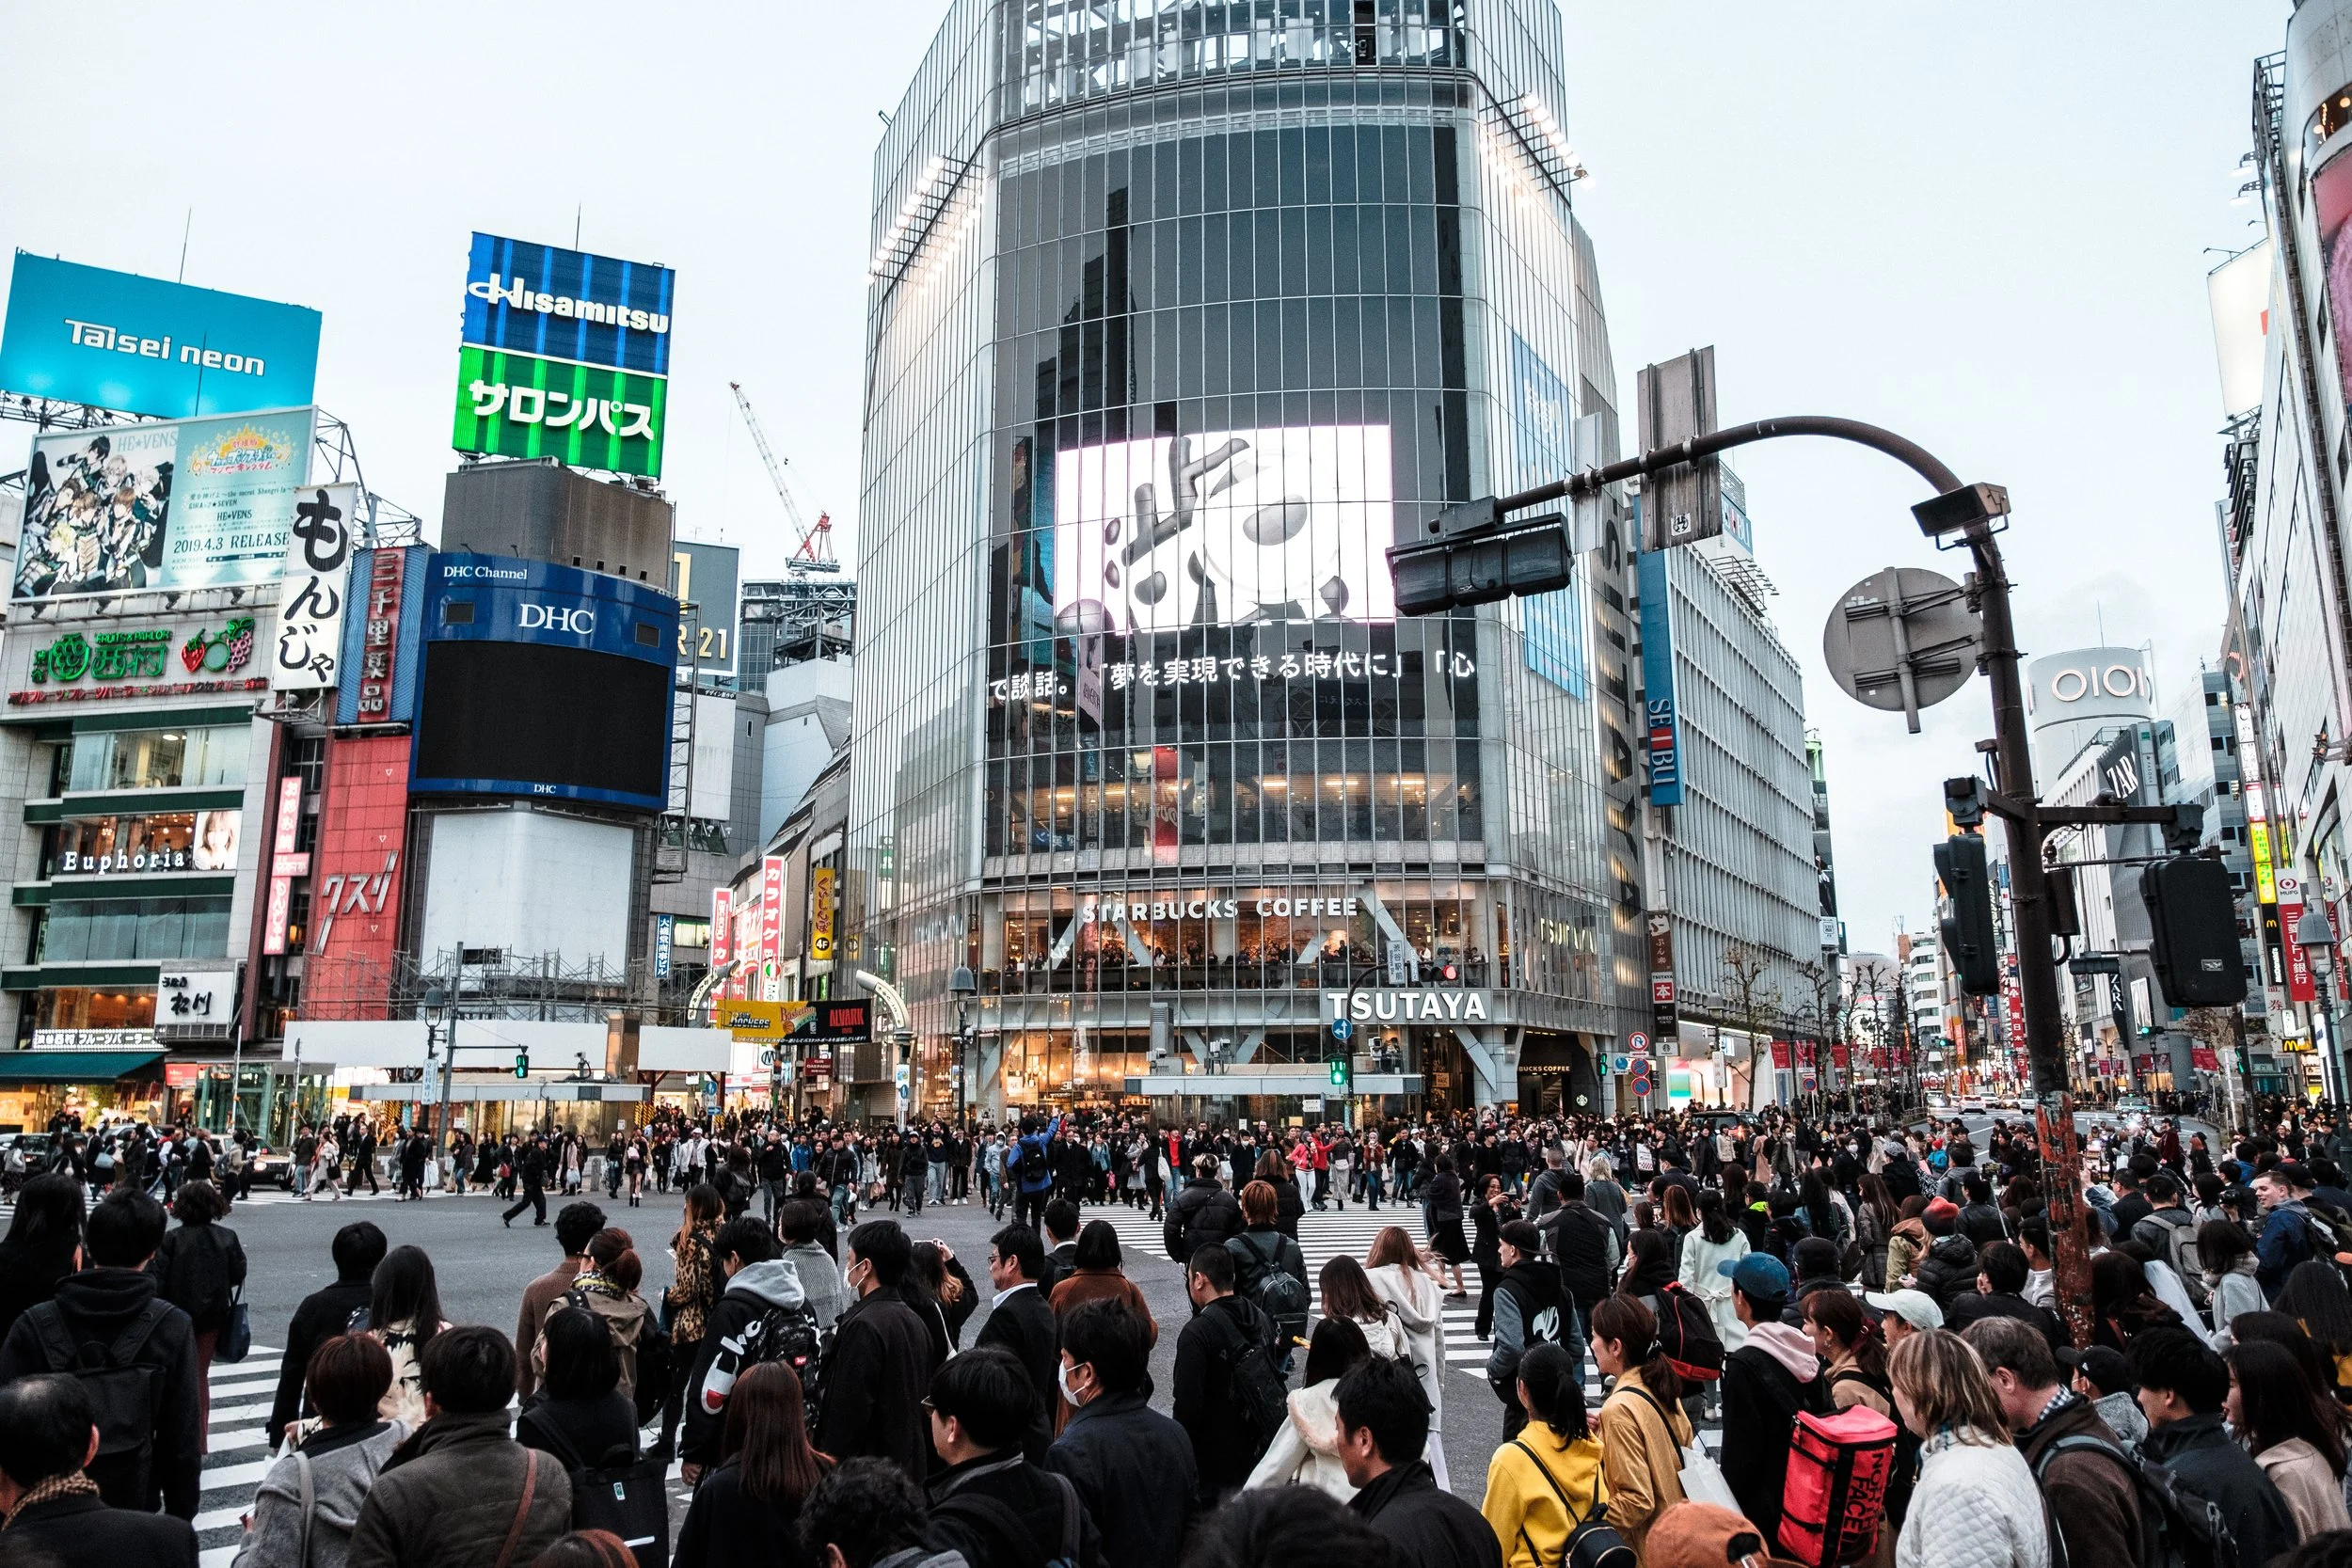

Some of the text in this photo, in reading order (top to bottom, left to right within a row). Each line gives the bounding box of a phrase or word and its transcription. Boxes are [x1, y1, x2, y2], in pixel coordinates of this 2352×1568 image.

[469, 273, 669, 334] Hisamitsu
[64, 318, 265, 377] Taisei neon
[469, 379, 655, 441] サロンパス
[173, 531, 290, 554] 2019.4.3 RELEASE
[278, 489, 349, 683] もんじゃ
[443, 565, 528, 580] DHC Channel
[358, 553, 399, 713] 三千里薬品
[518, 603, 595, 636] DHC
[91, 642, 168, 680] 西村
[990, 670, 1068, 701] で談話。
[1099, 649, 1402, 690] 「夢を実現できる時代に」
[1435, 649, 1475, 677] 「心
[2052, 664, 2146, 702] OIOI
[1648, 697, 1676, 785] SEIBU
[533, 784, 557, 795] DHC
[2106, 751, 2138, 799] ZAR
[63, 847, 185, 875] Euphoria
[313, 850, 400, 956] クスリ
[764, 867, 782, 941] カラオケ
[1083, 897, 1358, 924] STARBUCKS COFFEE
[816, 939, 829, 949] 4F
[1392, 943, 1404, 980] 渋谷駅前
[1327, 991, 1487, 1021] TSUTAYA
[1656, 984, 1671, 999] 本
[2109, 974, 2123, 1011] ZARA
[829, 1007, 865, 1027] ALVARK
[1843, 1475, 1871, 1533] FACE
